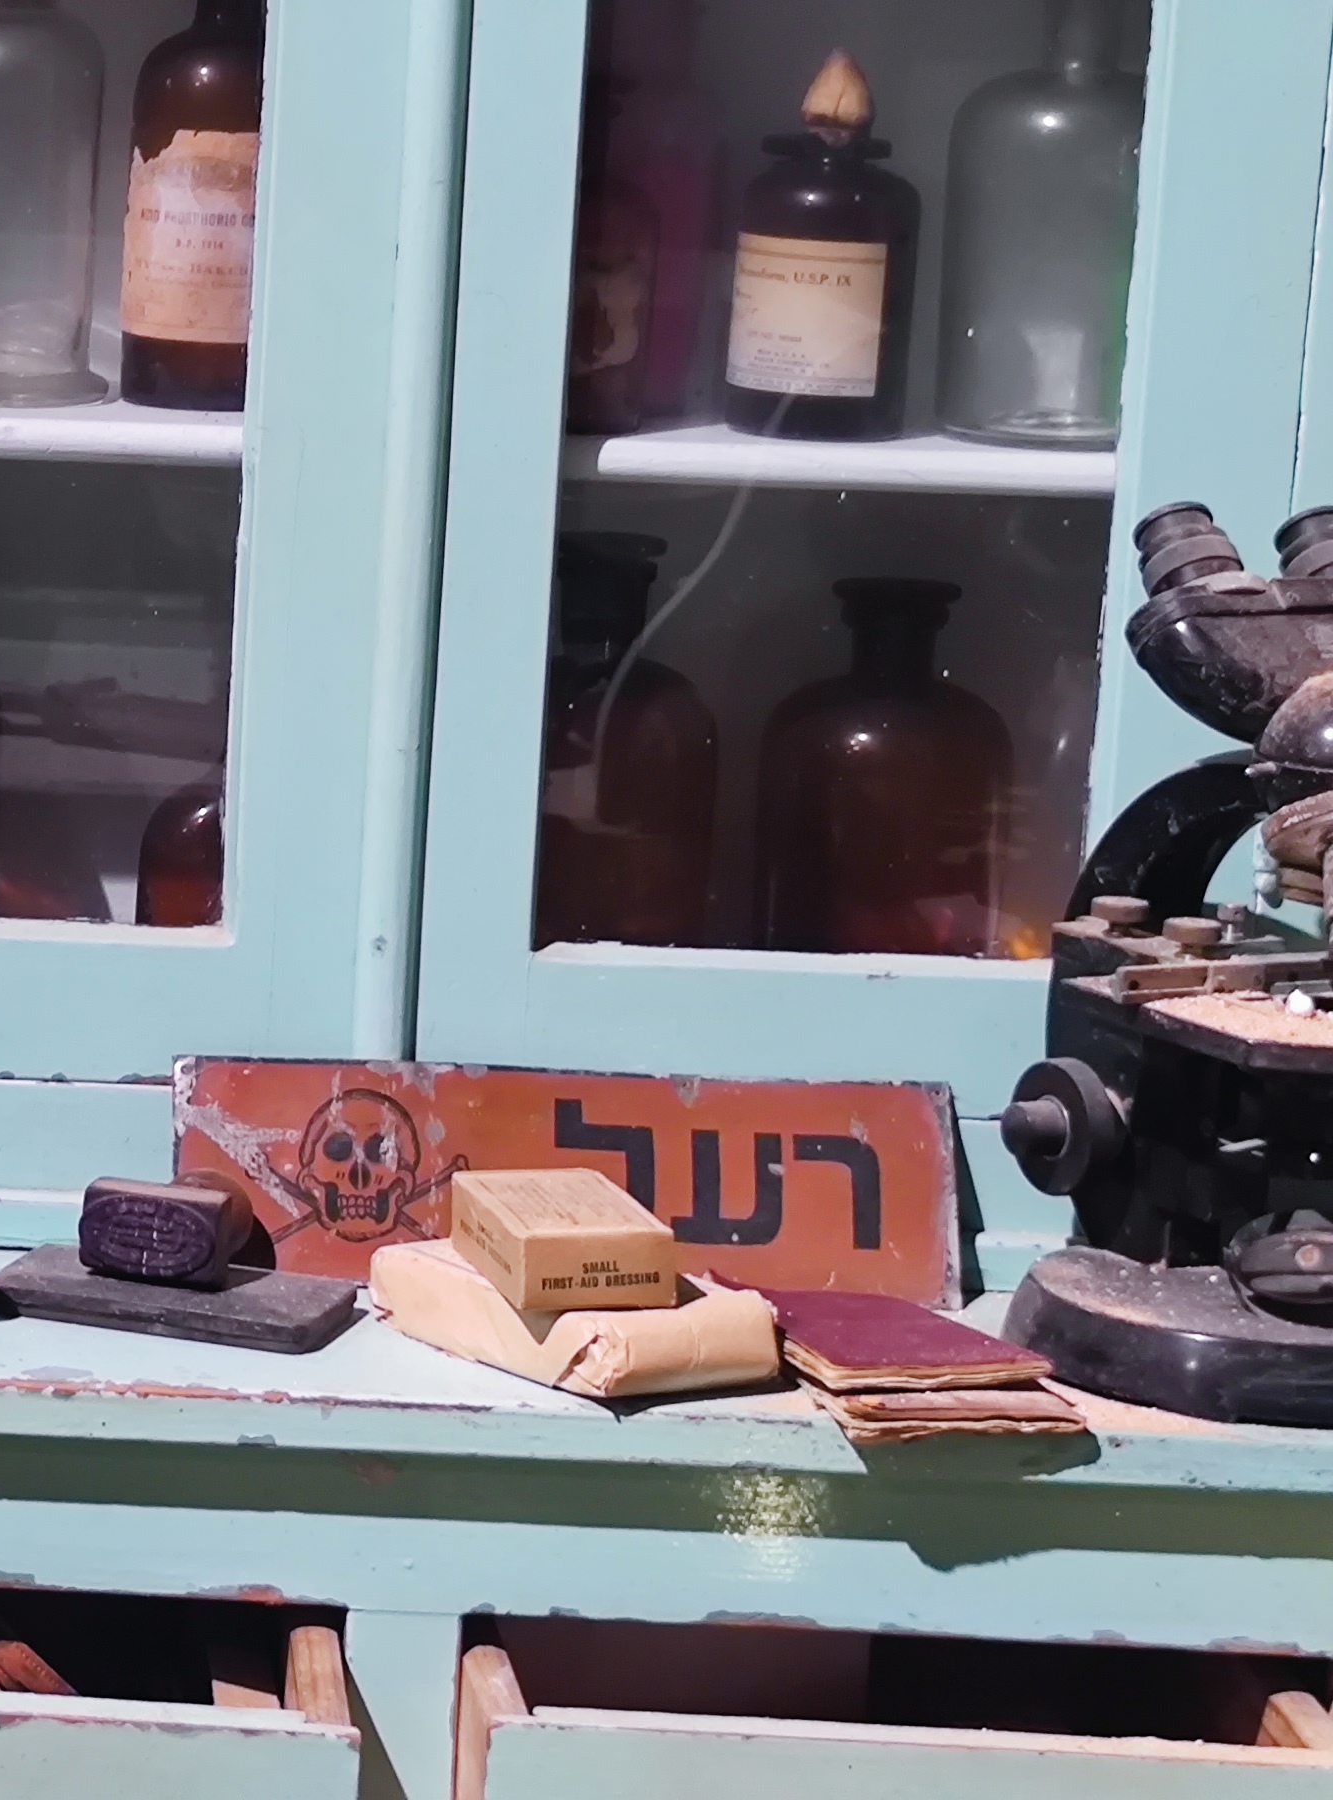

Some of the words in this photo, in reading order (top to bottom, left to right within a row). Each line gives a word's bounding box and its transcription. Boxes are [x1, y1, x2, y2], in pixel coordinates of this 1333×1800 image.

[554, 1098, 881, 1251] רעל
[582, 1260, 620, 1275] SMALL
[605, 1272, 661, 1287] DRESSING
